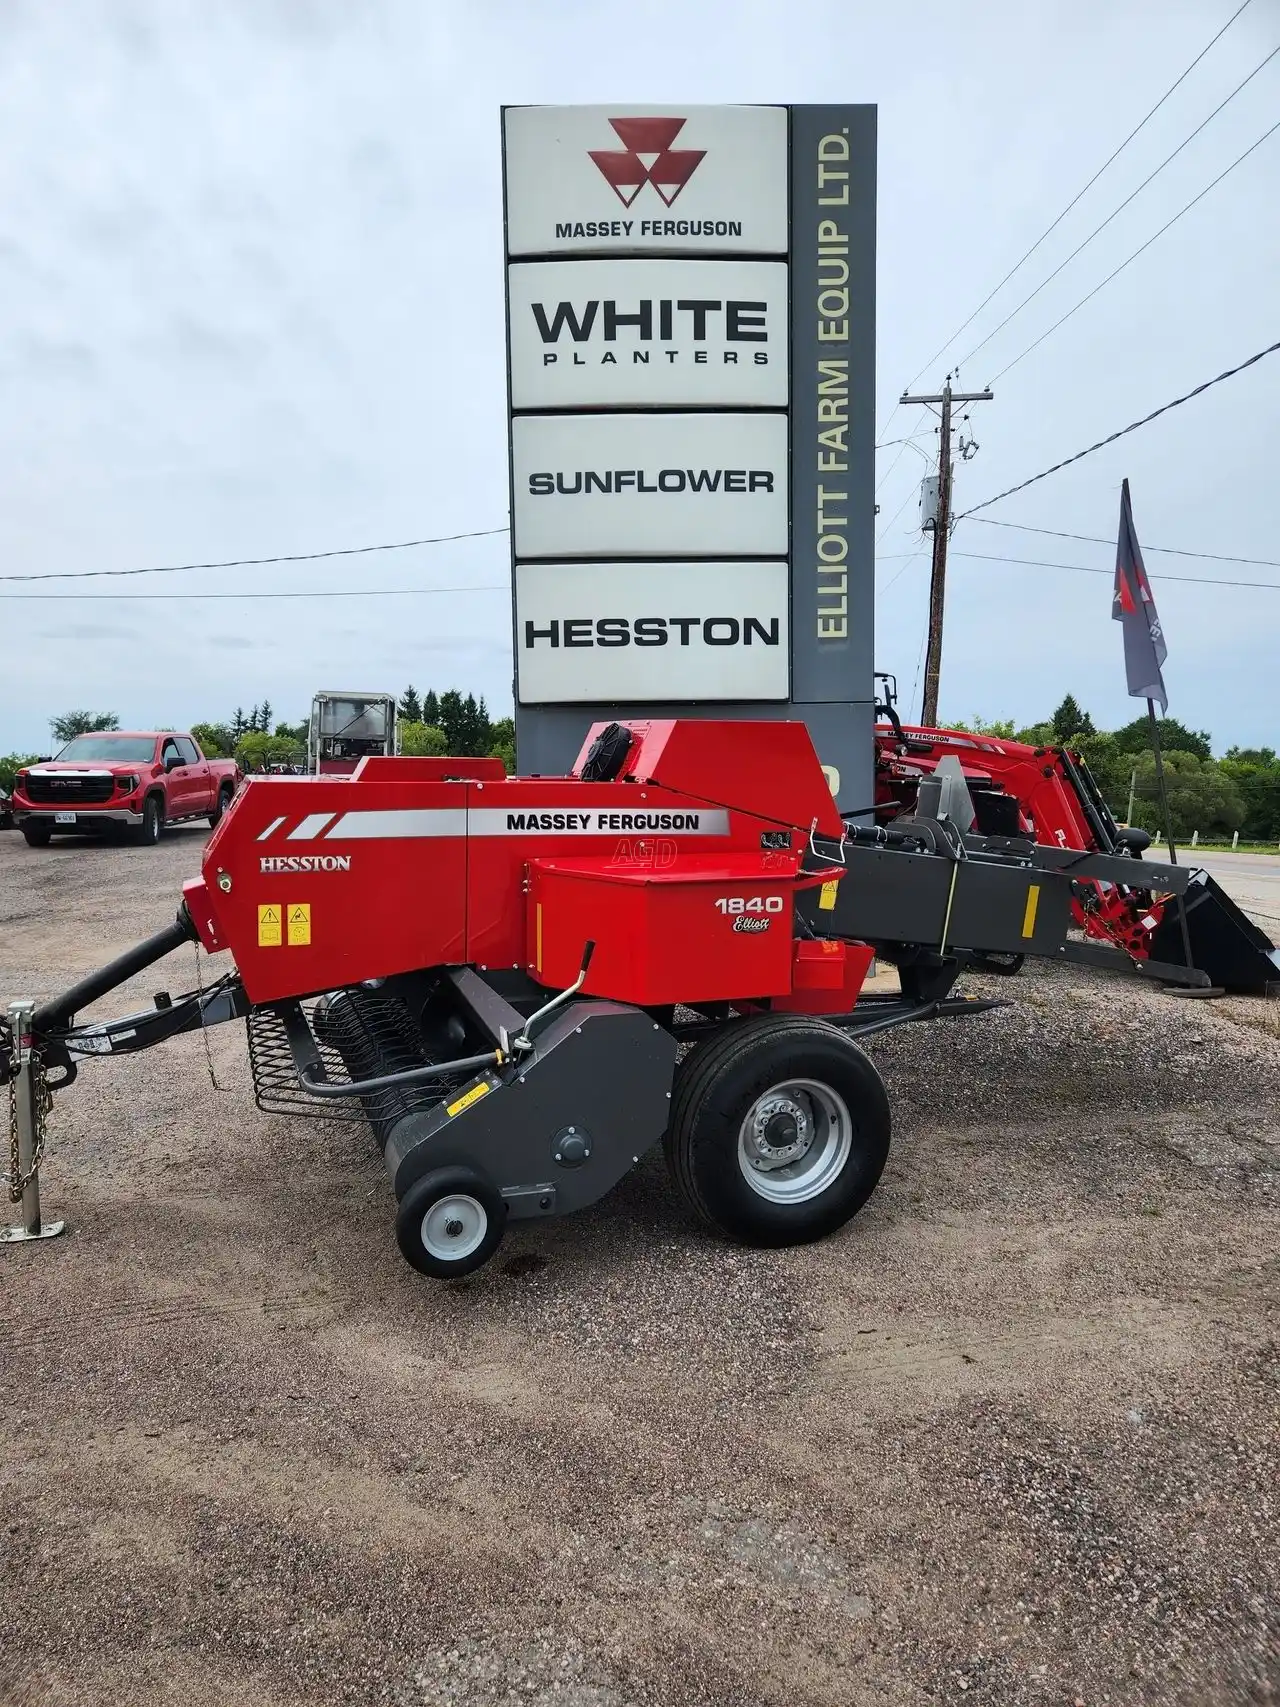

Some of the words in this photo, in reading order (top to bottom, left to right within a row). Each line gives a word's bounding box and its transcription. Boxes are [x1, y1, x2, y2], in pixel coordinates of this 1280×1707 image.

[817, 127, 850, 206] LTD.
[555, 221, 634, 238] MASSEY
[640, 220, 742, 237] FERGUSON
[817, 219, 850, 341] EQUIP
[531, 299, 768, 343] WHITE
[543, 350, 769, 366] PLANTERS
[817, 360, 849, 471] FARM
[528, 468, 774, 495] SUNFLOWER
[816, 484, 848, 638] ELLIOTT
[525, 617, 779, 648] HESSTON
[915, 733, 950, 743] FERGUSON
[506, 814, 591, 830] MASSEY
[597, 814, 700, 830] FERGUSON
[259, 855, 352, 873] HESSTON
[714, 896, 784, 915] 1840
[732, 915, 770, 932] Elliott
